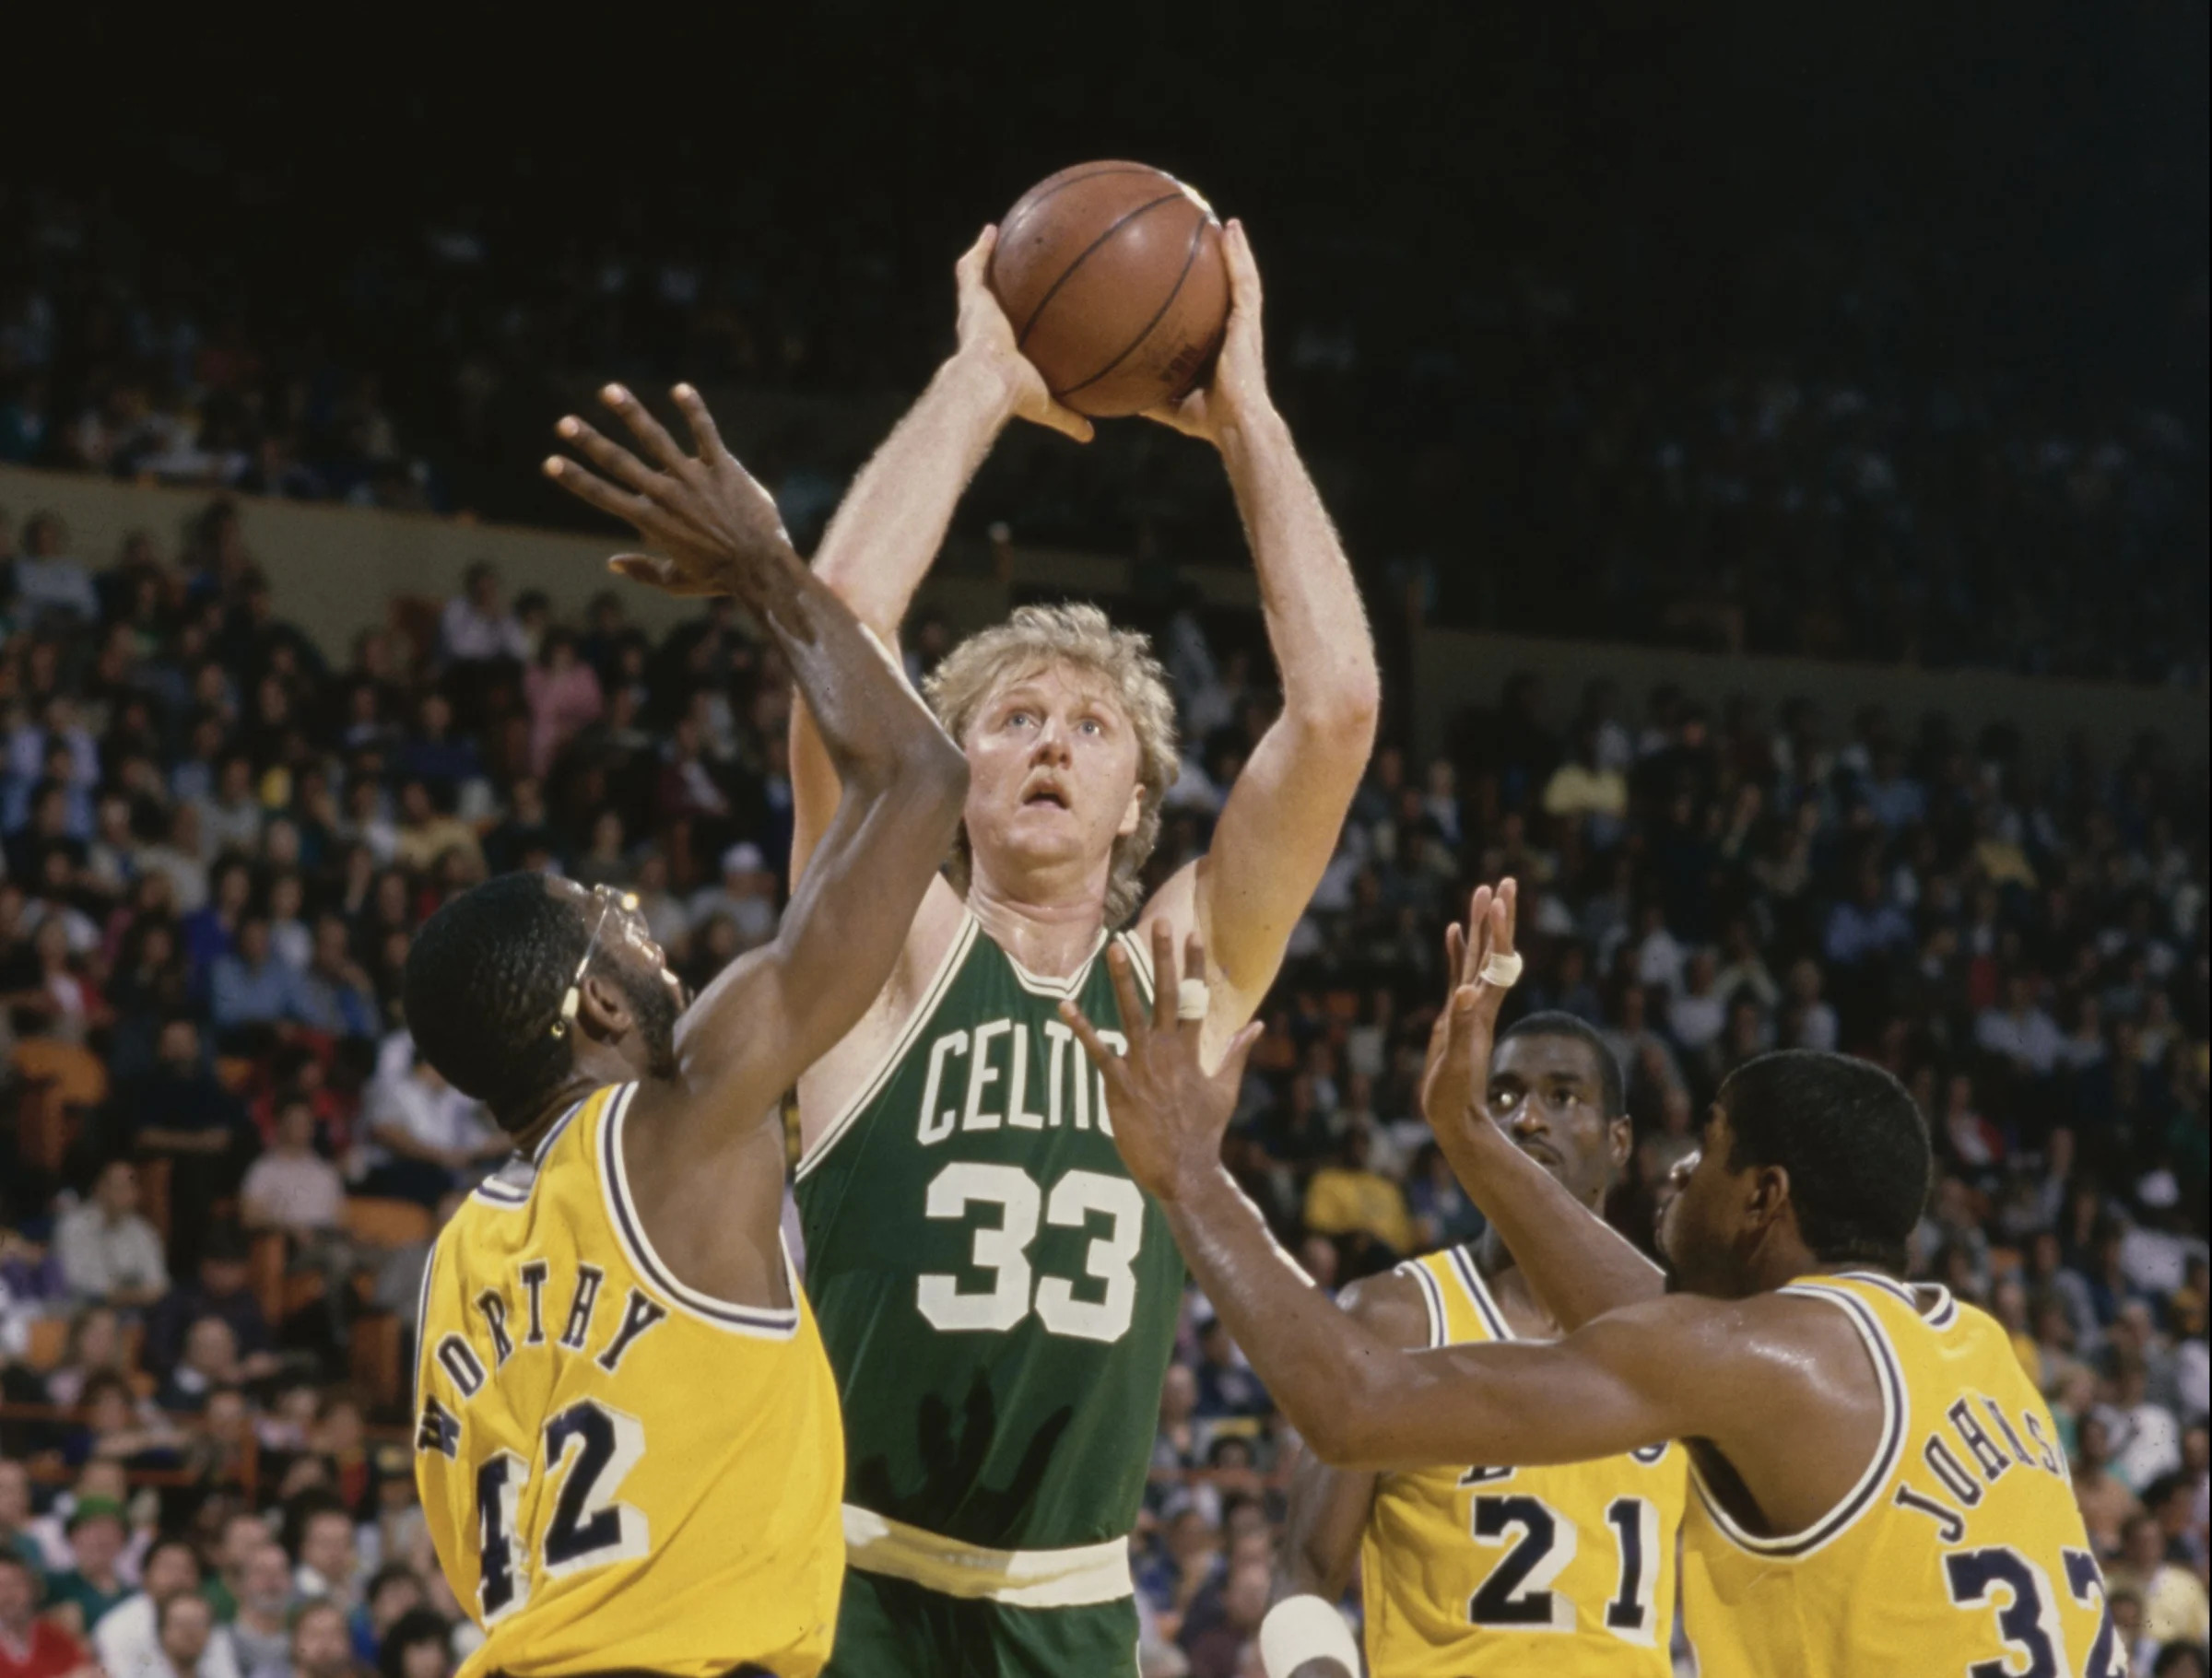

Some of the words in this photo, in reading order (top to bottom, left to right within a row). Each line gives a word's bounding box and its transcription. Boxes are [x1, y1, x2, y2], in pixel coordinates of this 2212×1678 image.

[917, 1161, 1145, 1344] 33
[416, 1258, 669, 1461] WORTHY
[1467, 1491, 1660, 1649] 21
